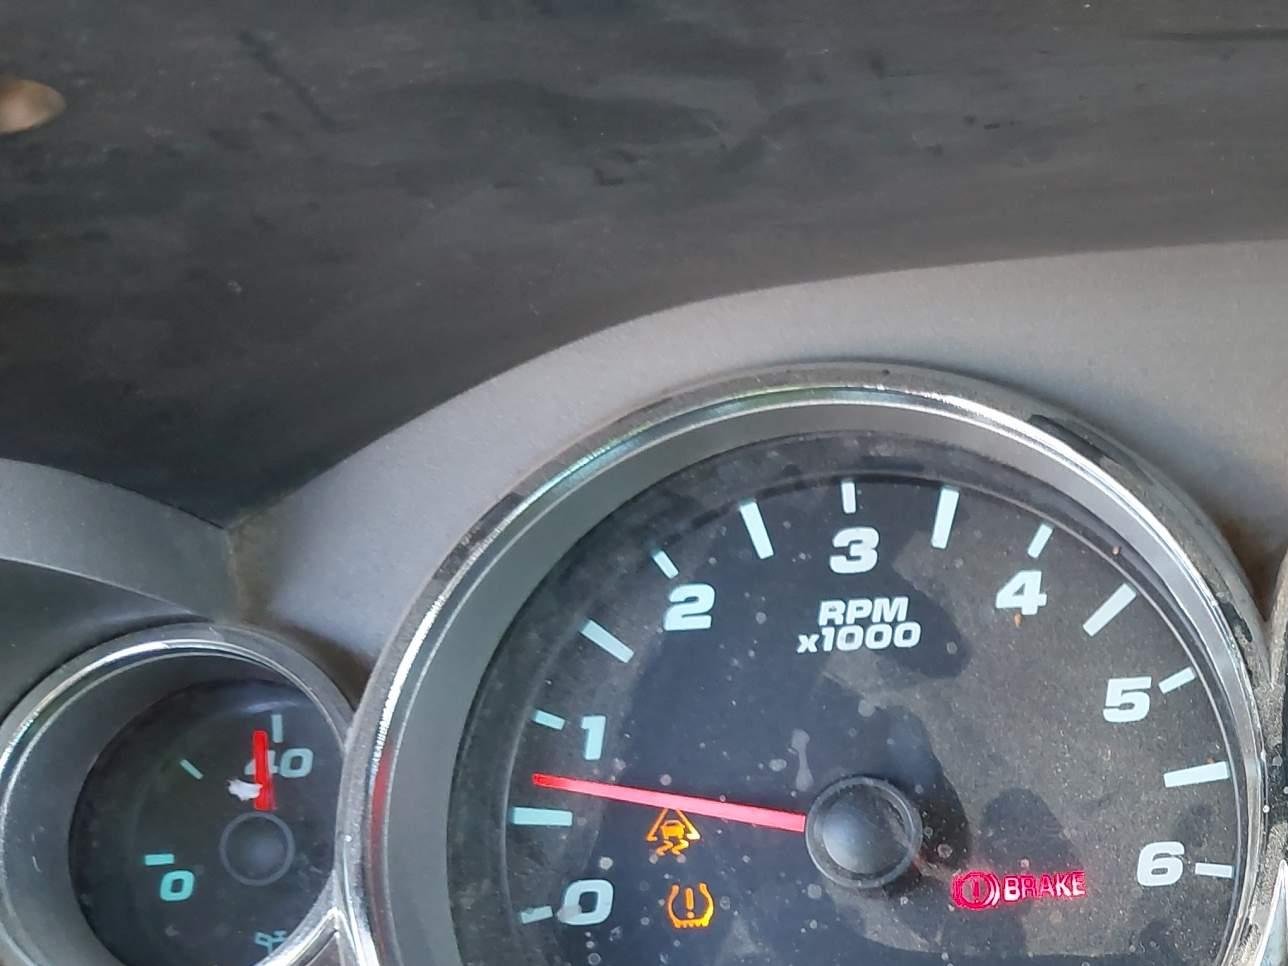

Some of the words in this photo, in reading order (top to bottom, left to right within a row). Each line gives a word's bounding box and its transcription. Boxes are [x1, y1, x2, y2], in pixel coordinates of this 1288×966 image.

[831, 526, 880, 575] 3
[664, 584, 715, 632] 2
[817, 596, 911, 627] RPM
[996, 569, 1048, 616] 4
[795, 622, 924, 656] x1000
[1103, 676, 1155, 726] 5
[580, 714, 608, 762] 1
[159, 869, 196, 902] 0
[1003, 870, 1087, 902] BRAKE
[1135, 841, 1187, 890] 6
[559, 879, 617, 927] 0
